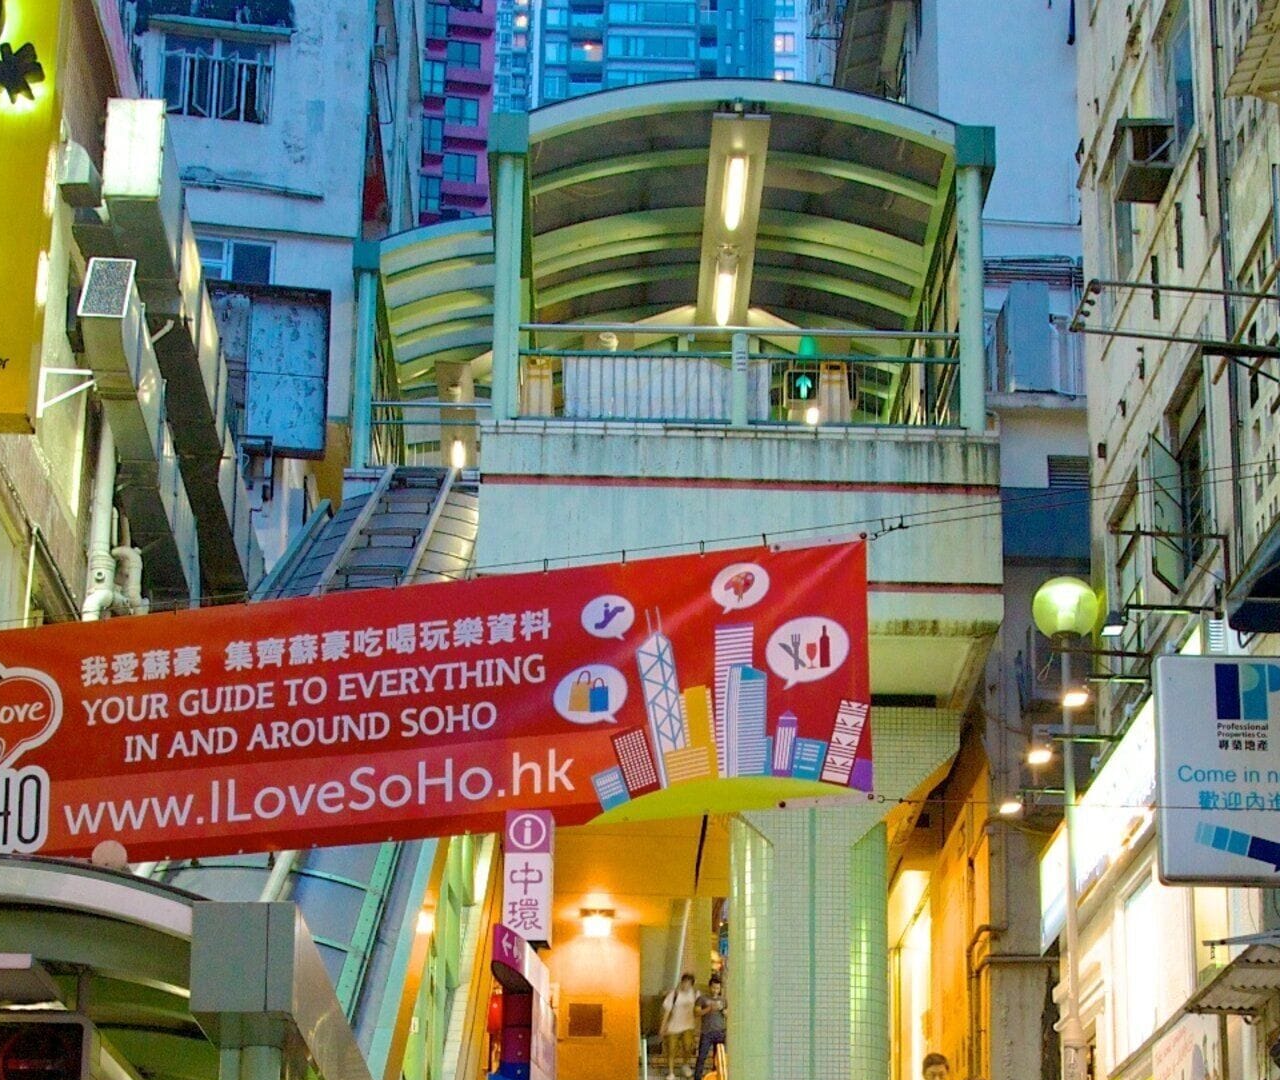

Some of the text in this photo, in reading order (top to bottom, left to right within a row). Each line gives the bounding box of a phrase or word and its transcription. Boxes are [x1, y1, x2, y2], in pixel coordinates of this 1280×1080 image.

[81, 654, 546, 727] YOUR GUIDE TO EVERYTHING
[124, 701, 497, 763] IN AND AROUND SOHO
[1217, 722, 1269, 731] Professional
[1217, 730, 1268, 739] Properties Co.
[63, 748, 575, 836] www.ILoveSoHo.hk
[1178, 765, 1237, 783] Come
[1244, 766, 1260, 783] in
[508, 861, 543, 931] 中環
